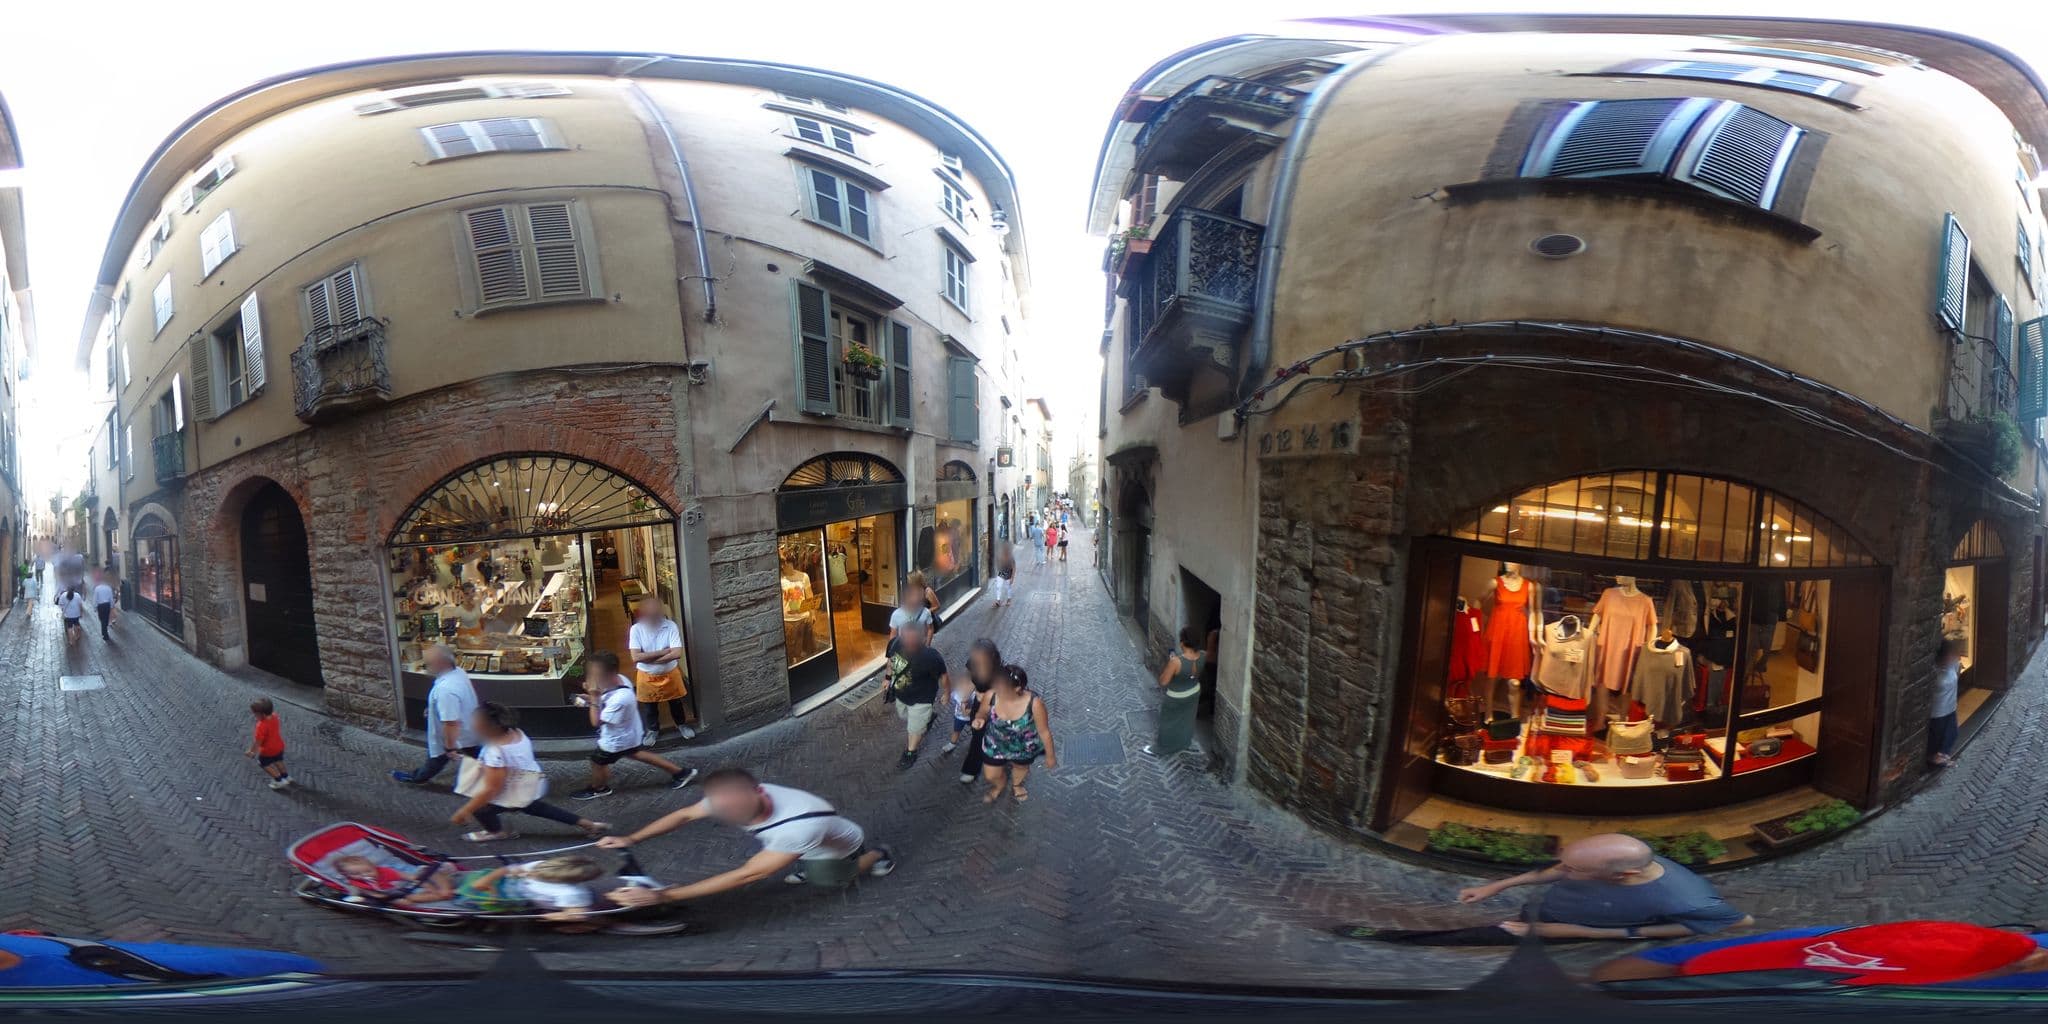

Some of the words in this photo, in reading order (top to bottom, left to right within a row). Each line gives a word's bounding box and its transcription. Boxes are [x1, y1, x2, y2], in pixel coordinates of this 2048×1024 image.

[1259, 431, 1273, 454] 10
[1276, 428, 1291, 452] 12
[1301, 423, 1320, 449] 14
[1330, 422, 1351, 449] 16
